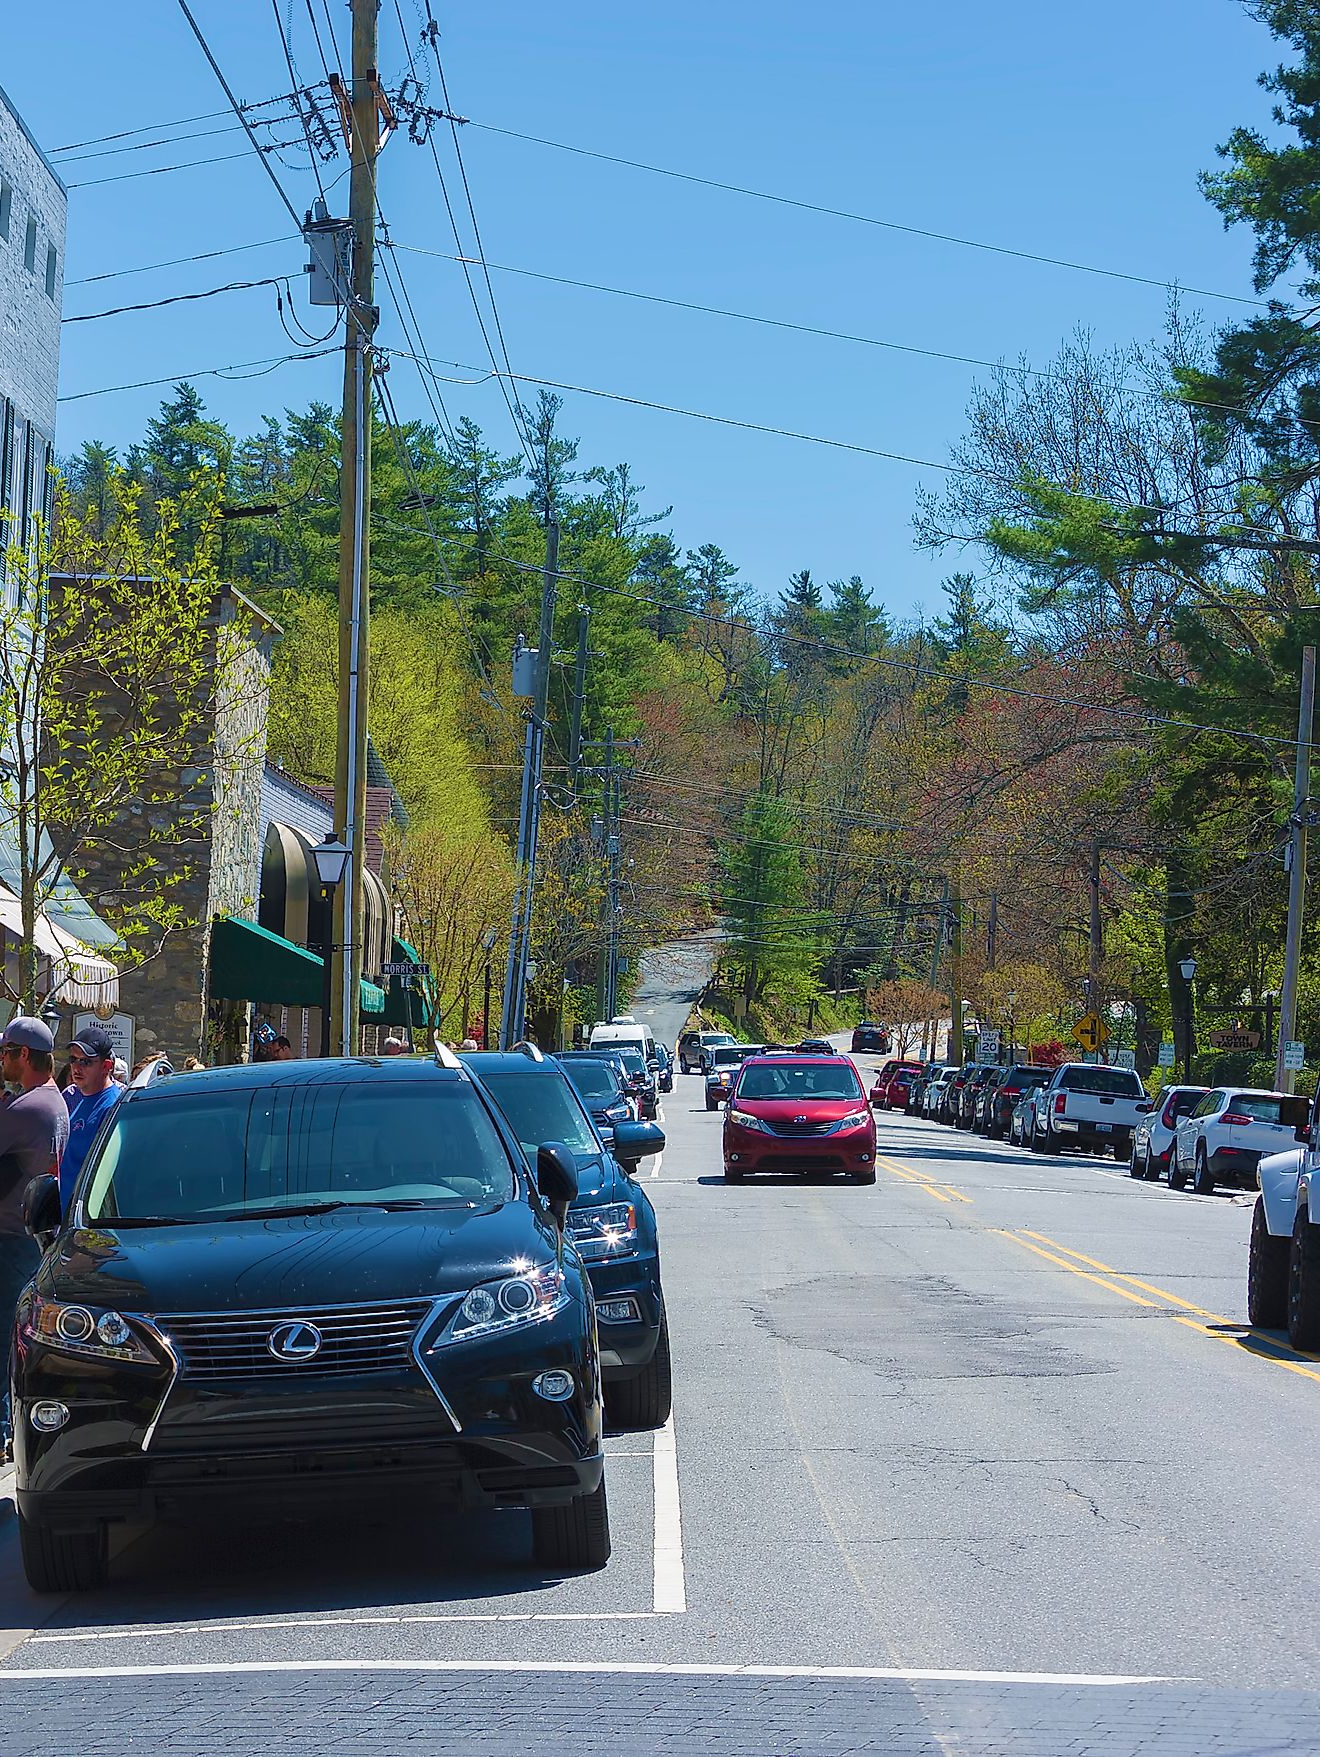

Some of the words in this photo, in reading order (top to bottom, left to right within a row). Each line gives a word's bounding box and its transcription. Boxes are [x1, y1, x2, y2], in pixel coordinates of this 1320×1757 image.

[384, 965, 414, 974] MORRIS
[89, 1021, 119, 1030] Historic
[981, 1042, 996, 1051] 20
